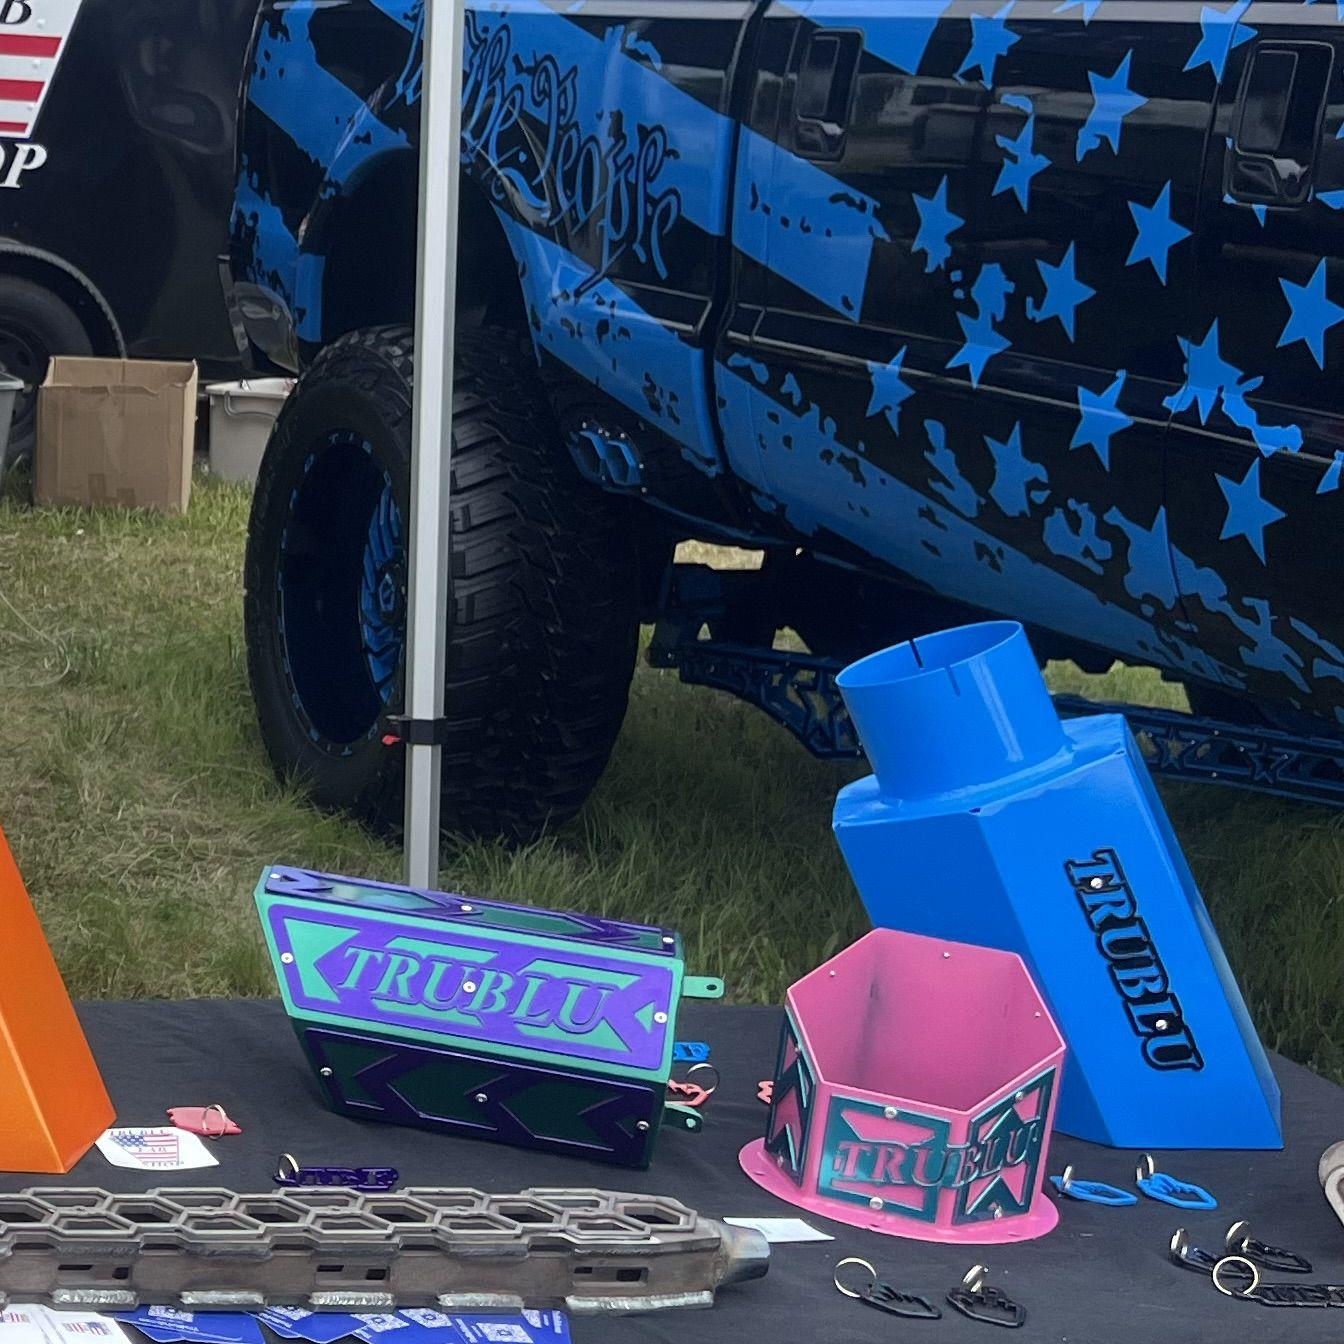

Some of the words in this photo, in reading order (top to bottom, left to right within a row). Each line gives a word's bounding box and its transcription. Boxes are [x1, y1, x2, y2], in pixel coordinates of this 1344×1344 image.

[336, 940, 614, 1034] TRUBLU
[1063, 846, 1205, 1073] TRUBLU
[838, 1118, 1039, 1191] TRUBLU
